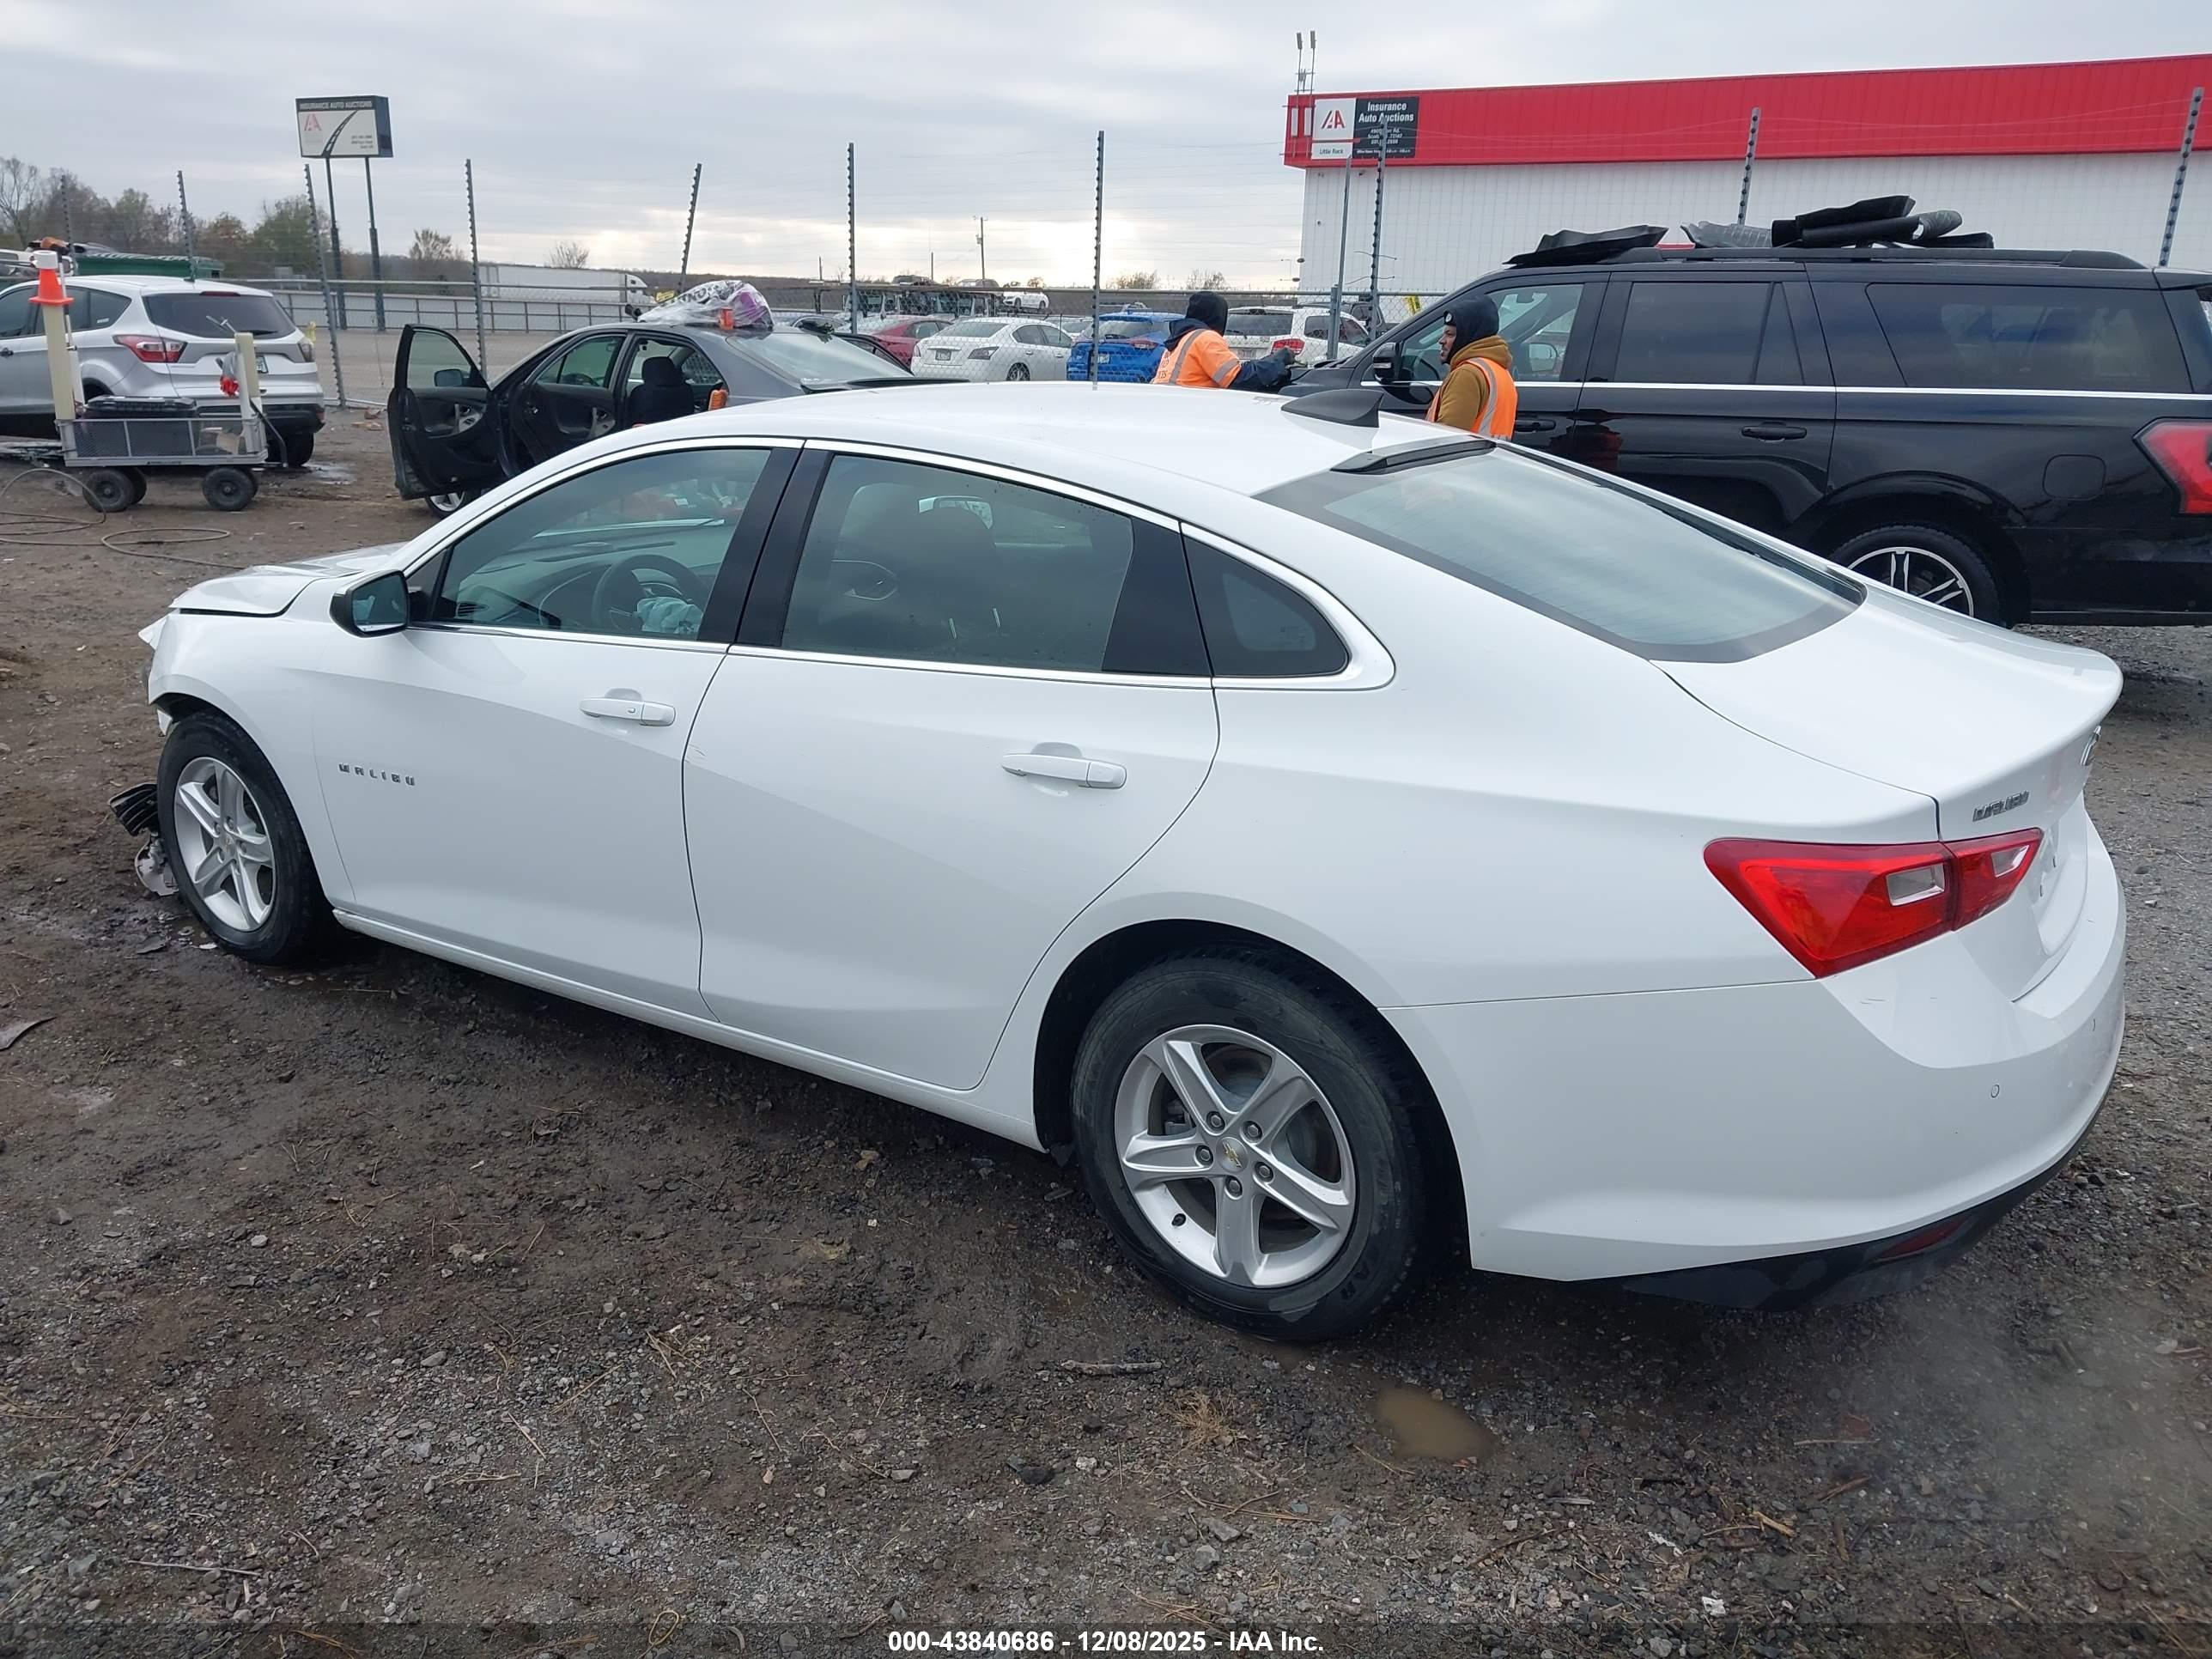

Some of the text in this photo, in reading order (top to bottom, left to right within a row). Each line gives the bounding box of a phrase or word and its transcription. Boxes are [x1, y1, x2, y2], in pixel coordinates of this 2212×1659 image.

[1367, 101, 1407, 112] Insurance
[1358, 112, 1377, 123] Auto
[338, 762, 416, 787] MALIBU
